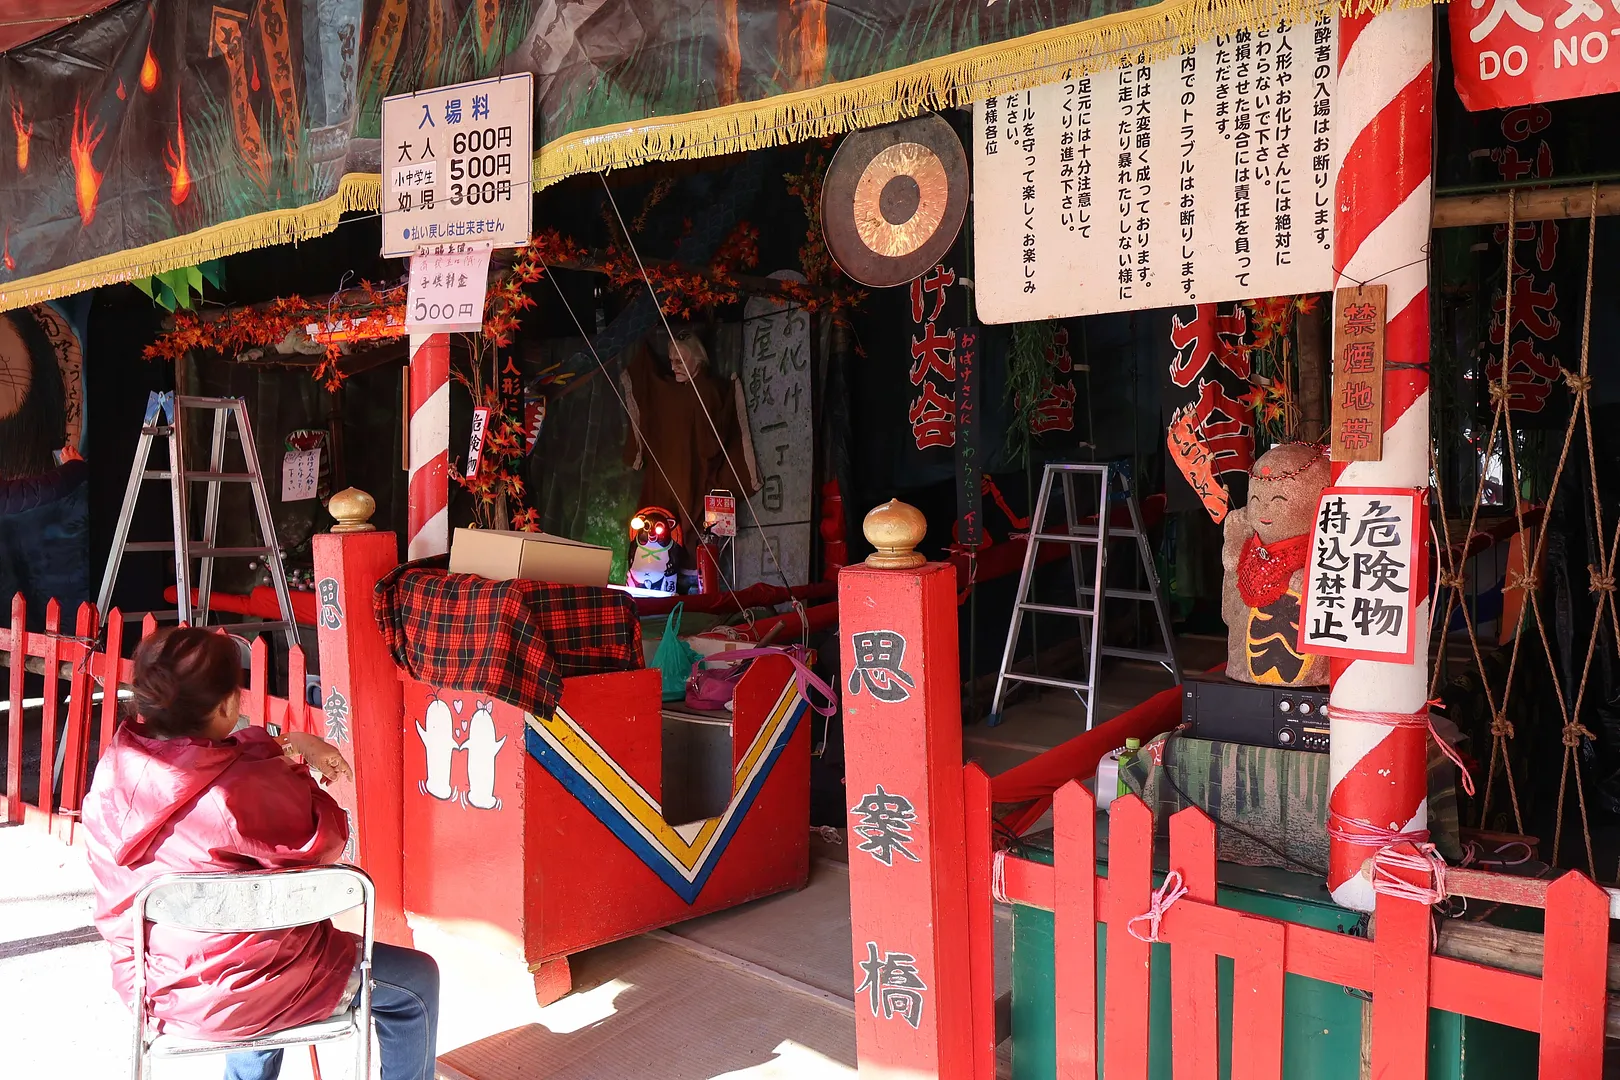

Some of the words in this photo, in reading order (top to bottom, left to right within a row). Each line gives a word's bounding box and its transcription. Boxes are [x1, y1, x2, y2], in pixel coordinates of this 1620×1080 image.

[1470, 0, 1620, 42] 火
[1479, 45, 1528, 81] DO
[1554, 28, 1620, 69] NO
[418, 93, 490, 129] 入場料
[1006, 80, 1020, 146] ださい。
[1215, 33, 1231, 141] いただきます。
[398, 137, 435, 162] 大人
[453, 126, 512, 154] 600円
[985, 81, 998, 156] 客様各位
[395, 169, 433, 187] 小中学生
[450, 153, 512, 181] 500円
[1234, 26, 1251, 287] 破損させた場合には責任を負って
[398, 189, 435, 213] 幼児
[450, 180, 512, 206] 300円
[1022, 82, 1036, 294] ールを守って楽しくお楽しみ
[411, 218, 504, 240] 払い戻しは出来ません
[415, 297, 473, 321] 500円
[421, 272, 468, 289] 子供料金
[1340, 303, 1376, 450] 禁煙地帯
[1309, 497, 1350, 643] 持込禁止
[1350, 499, 1409, 637] 危険物
[848, 629, 928, 1031] 思案橋
